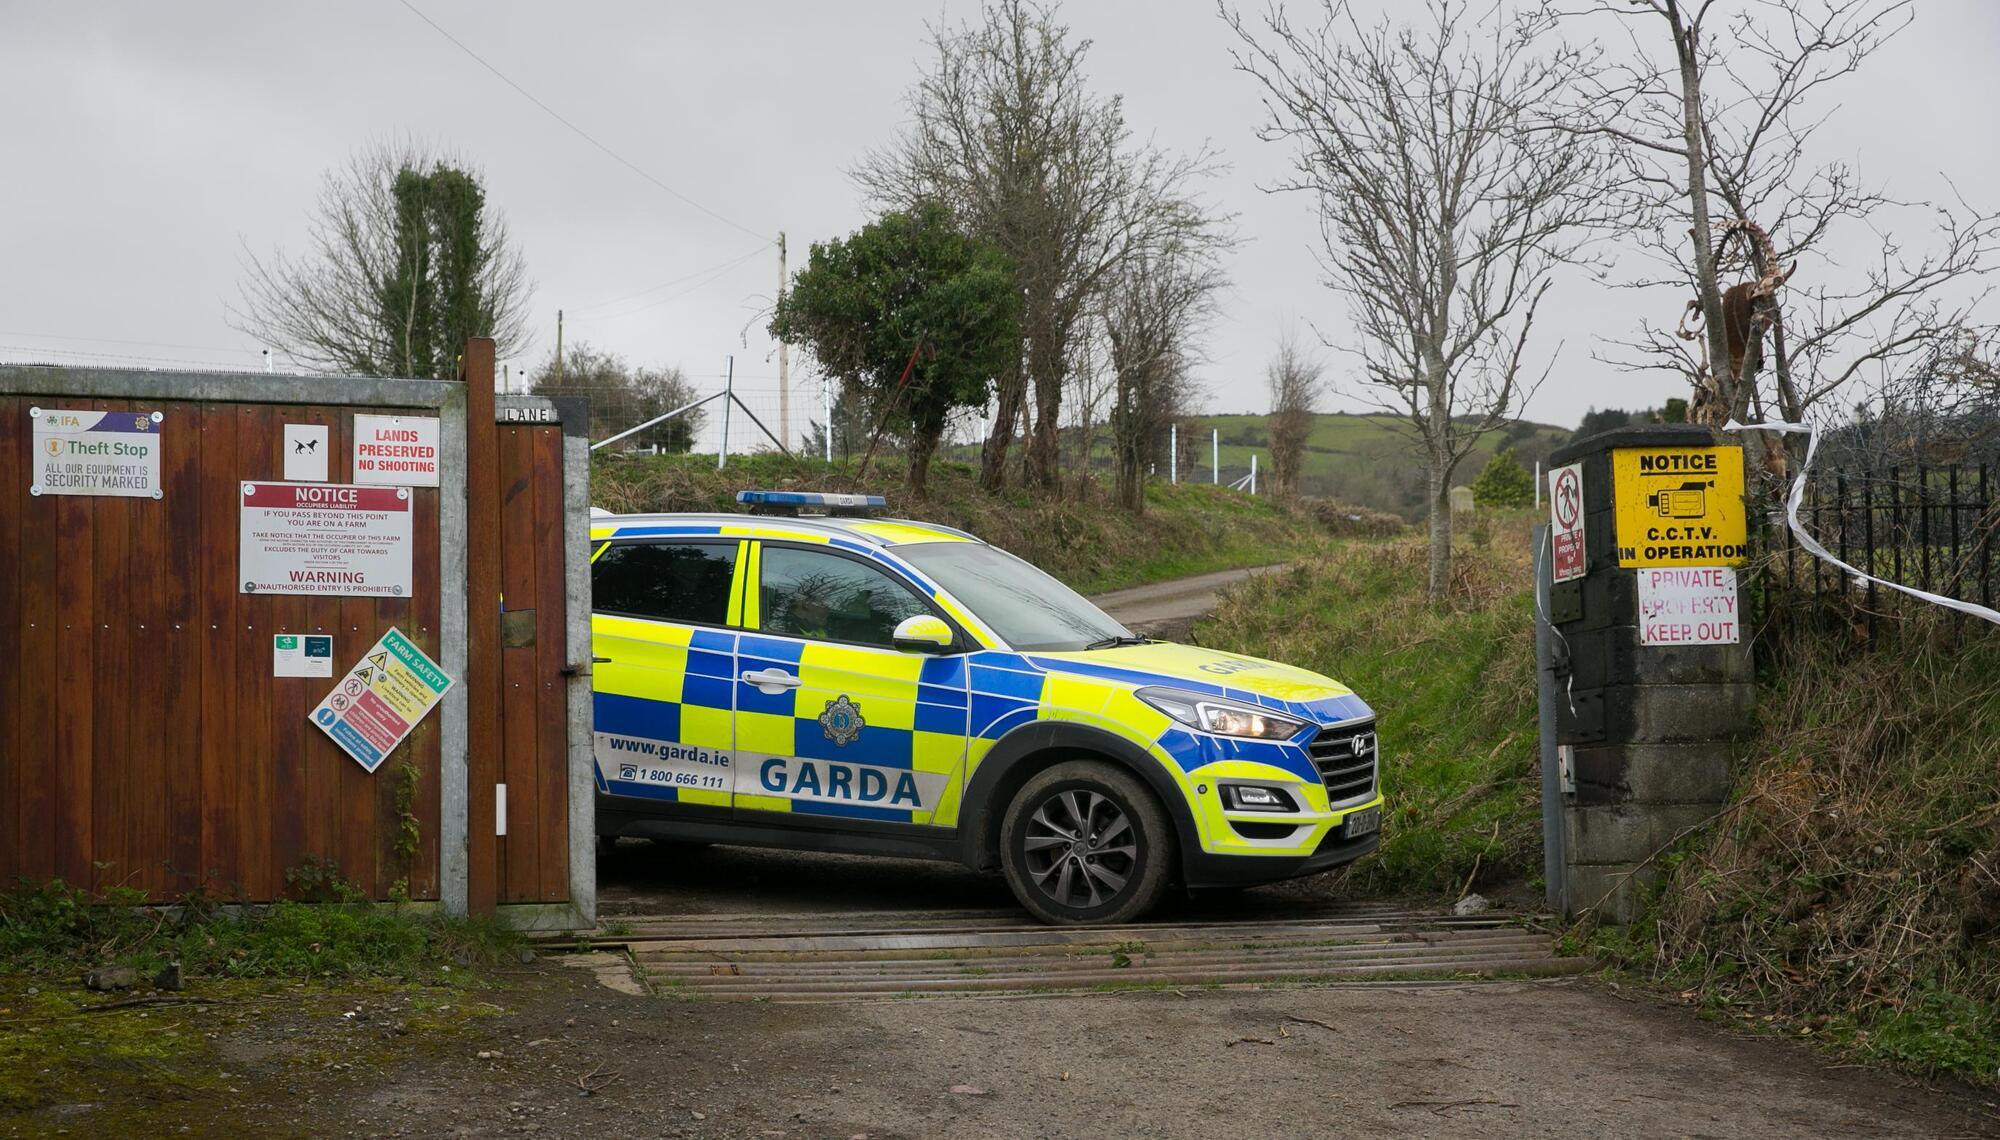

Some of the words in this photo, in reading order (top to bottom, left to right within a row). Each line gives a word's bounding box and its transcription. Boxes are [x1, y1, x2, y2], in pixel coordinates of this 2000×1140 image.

[61, 416, 80, 426] IFA
[508, 409, 547, 421] LANE
[375, 429, 418, 442] LANDS
[68, 440, 109, 455] Theft
[114, 442, 148, 459] Stop
[358, 444, 434, 458] PRESERVED
[45, 463, 62, 474] ALL
[65, 464, 83, 474] OUR
[86, 464, 136, 475] EQUIPMENT
[140, 466, 148, 475] IS
[358, 460, 374, 470] NO
[378, 460, 435, 472] SHOOTING
[1640, 454, 1717, 470] NOTICE
[45, 474, 98, 487] SECURITY
[102, 475, 148, 489] MARKED
[296, 487, 358, 503] NOTICE
[1647, 527, 1718, 541] C.C.T.V.
[1619, 547, 1636, 560] IN
[1644, 545, 1747, 560] OPERATION
[289, 570, 364, 583] WARNING
[1652, 570, 1723, 589] PRIVATE
[255, 583, 315, 591] UNAUTHORISED
[1646, 623, 1691, 641] KEEP
[1698, 622, 1733, 641] OUT
[387, 636, 414, 661] FARM
[412, 659, 445, 687] SAFETY
[610, 738, 729, 767] www.garda.ie
[640, 769, 647, 779] 1
[650, 770, 672, 782] 800
[676, 773, 698, 785] 666
[702, 776, 723, 788] 111
[760, 758, 922, 807] GARDA
